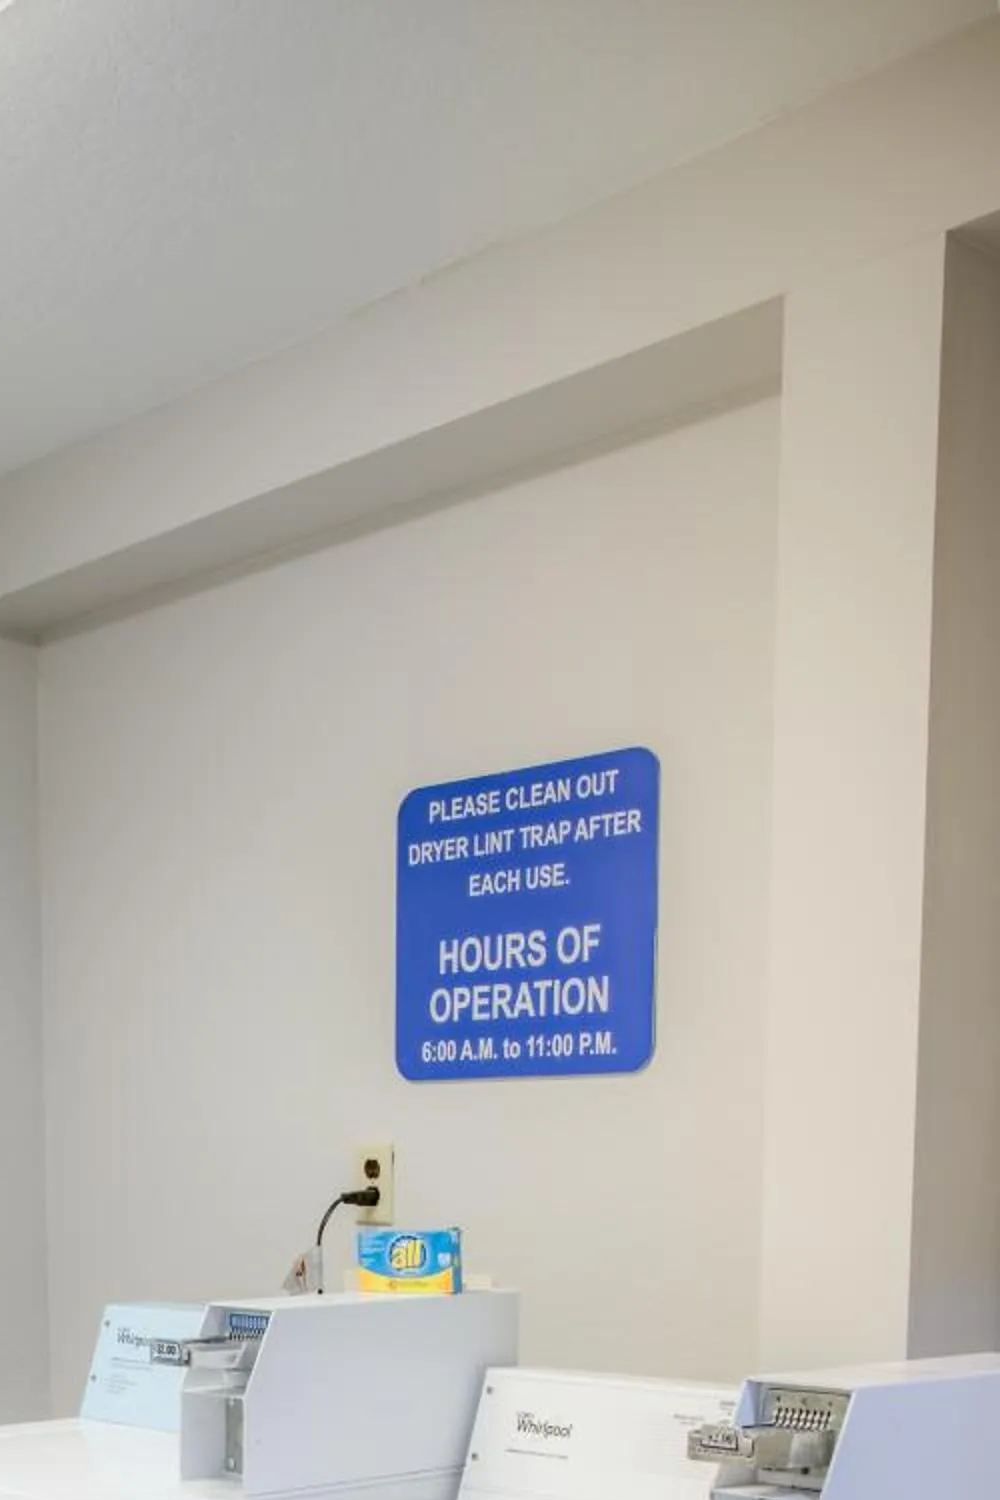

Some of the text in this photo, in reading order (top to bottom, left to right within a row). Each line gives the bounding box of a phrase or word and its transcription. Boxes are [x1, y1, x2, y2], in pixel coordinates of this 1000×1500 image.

[429, 769, 619, 823] PLEASE CLEAN OUT
[408, 809, 641, 866] DRYER LINT TRAP AFTER
[469, 863, 570, 897] EACH USE.
[439, 924, 601, 975] HOURS OF
[429, 975, 609, 1024] OPERATION
[421, 1031, 617, 1062] 6:00 A.M. to 11:00 P.M.
[391, 1239, 421, 1269] all
[517, 1416, 573, 1439] Whirlpool
